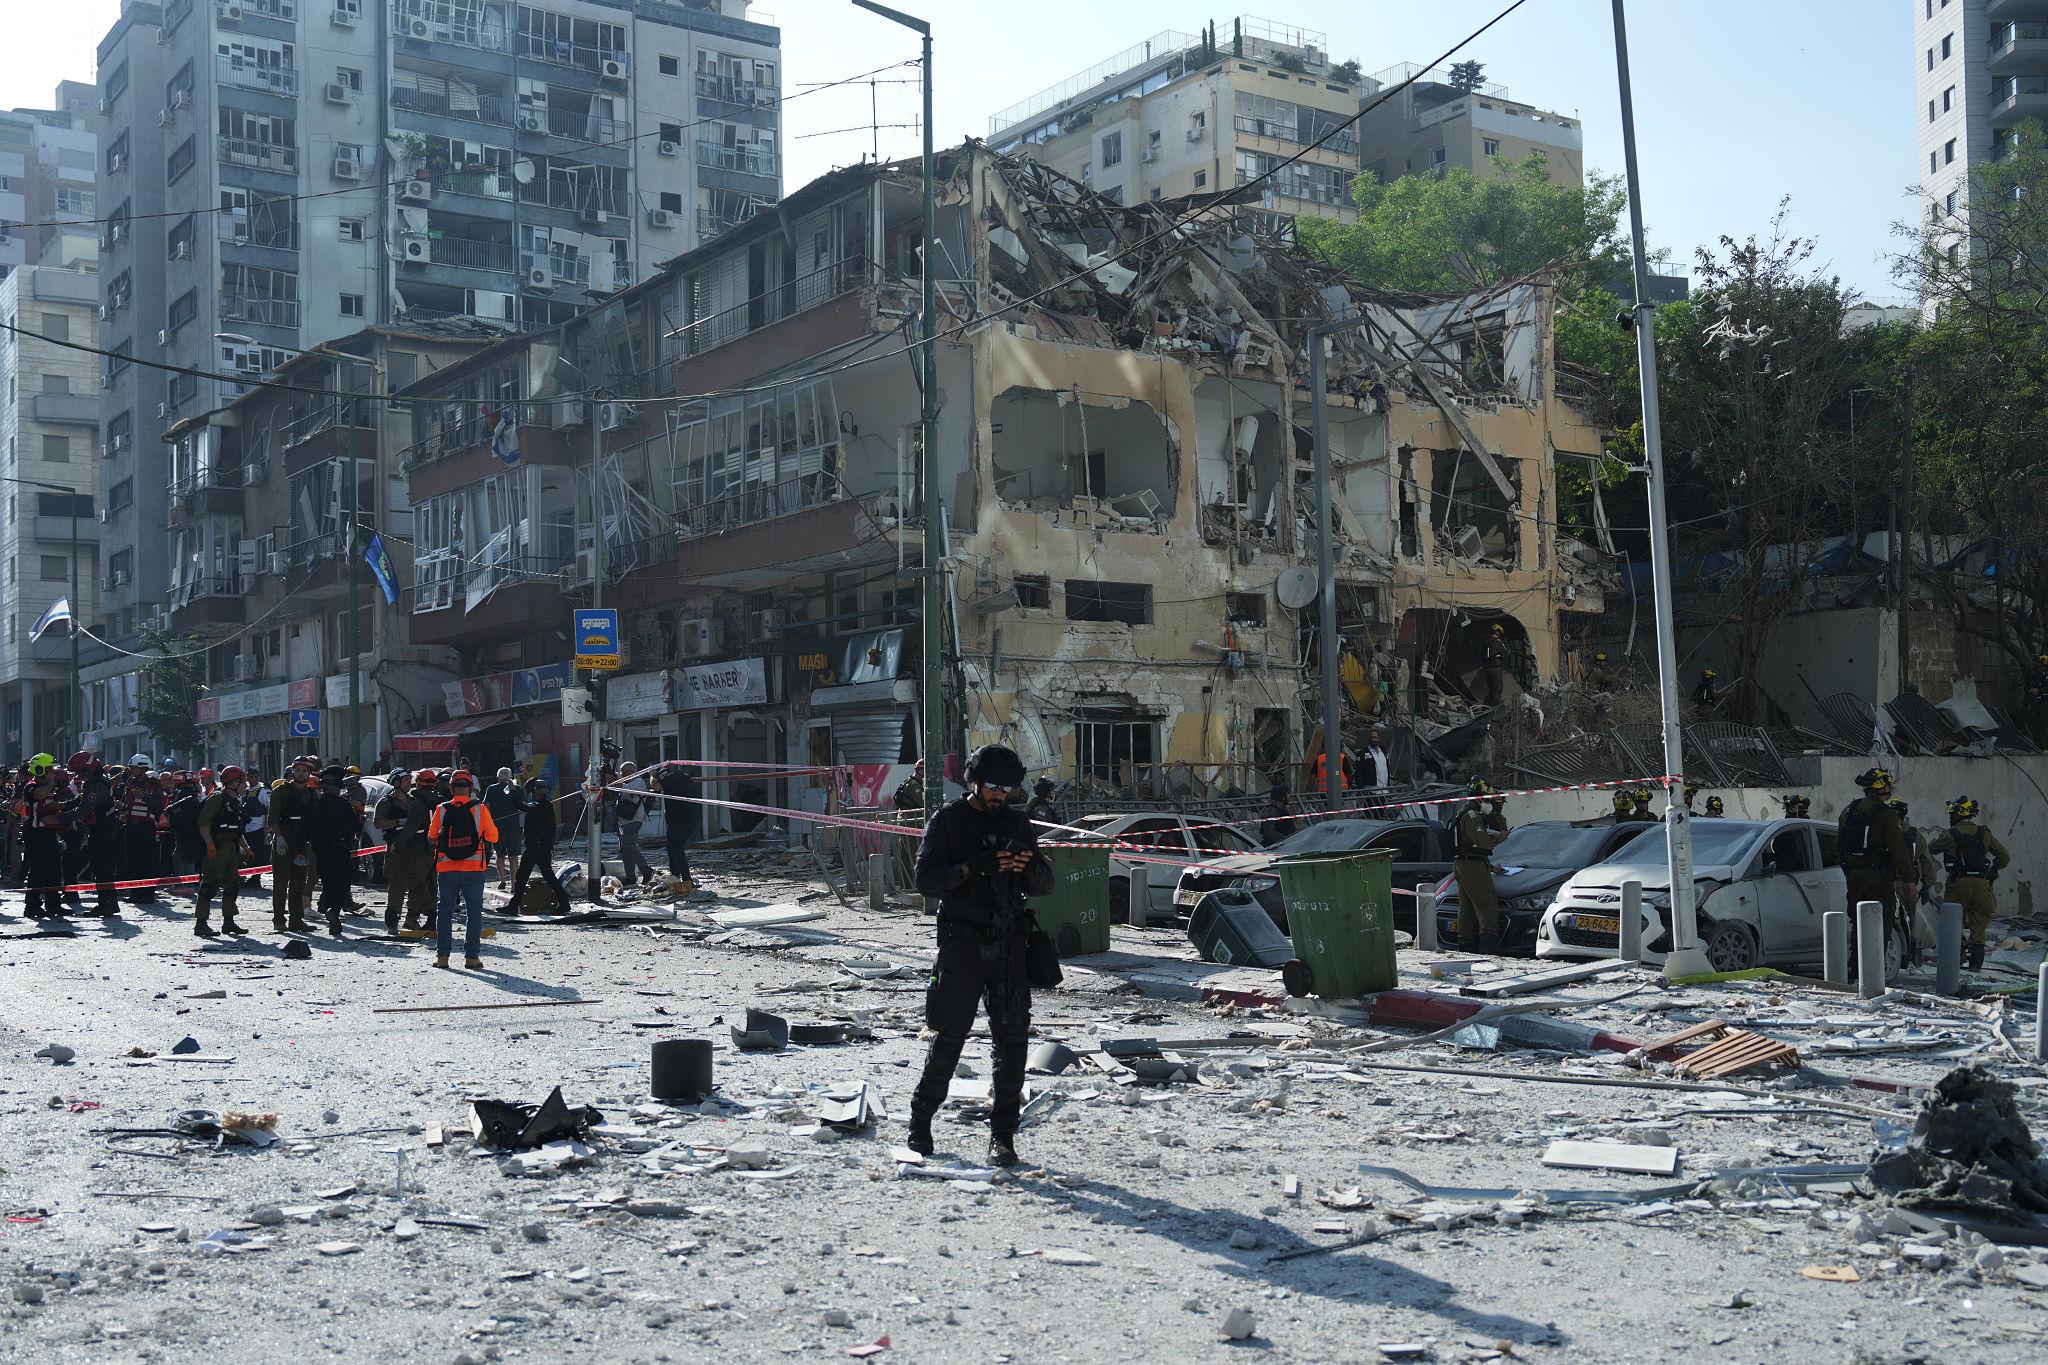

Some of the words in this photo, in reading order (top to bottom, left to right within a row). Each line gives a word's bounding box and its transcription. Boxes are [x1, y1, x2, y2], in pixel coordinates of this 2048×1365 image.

[600, 658, 616, 666] 22:00
[1079, 908, 1096, 924] 20
[1578, 916, 1619, 931] 23-642-3
